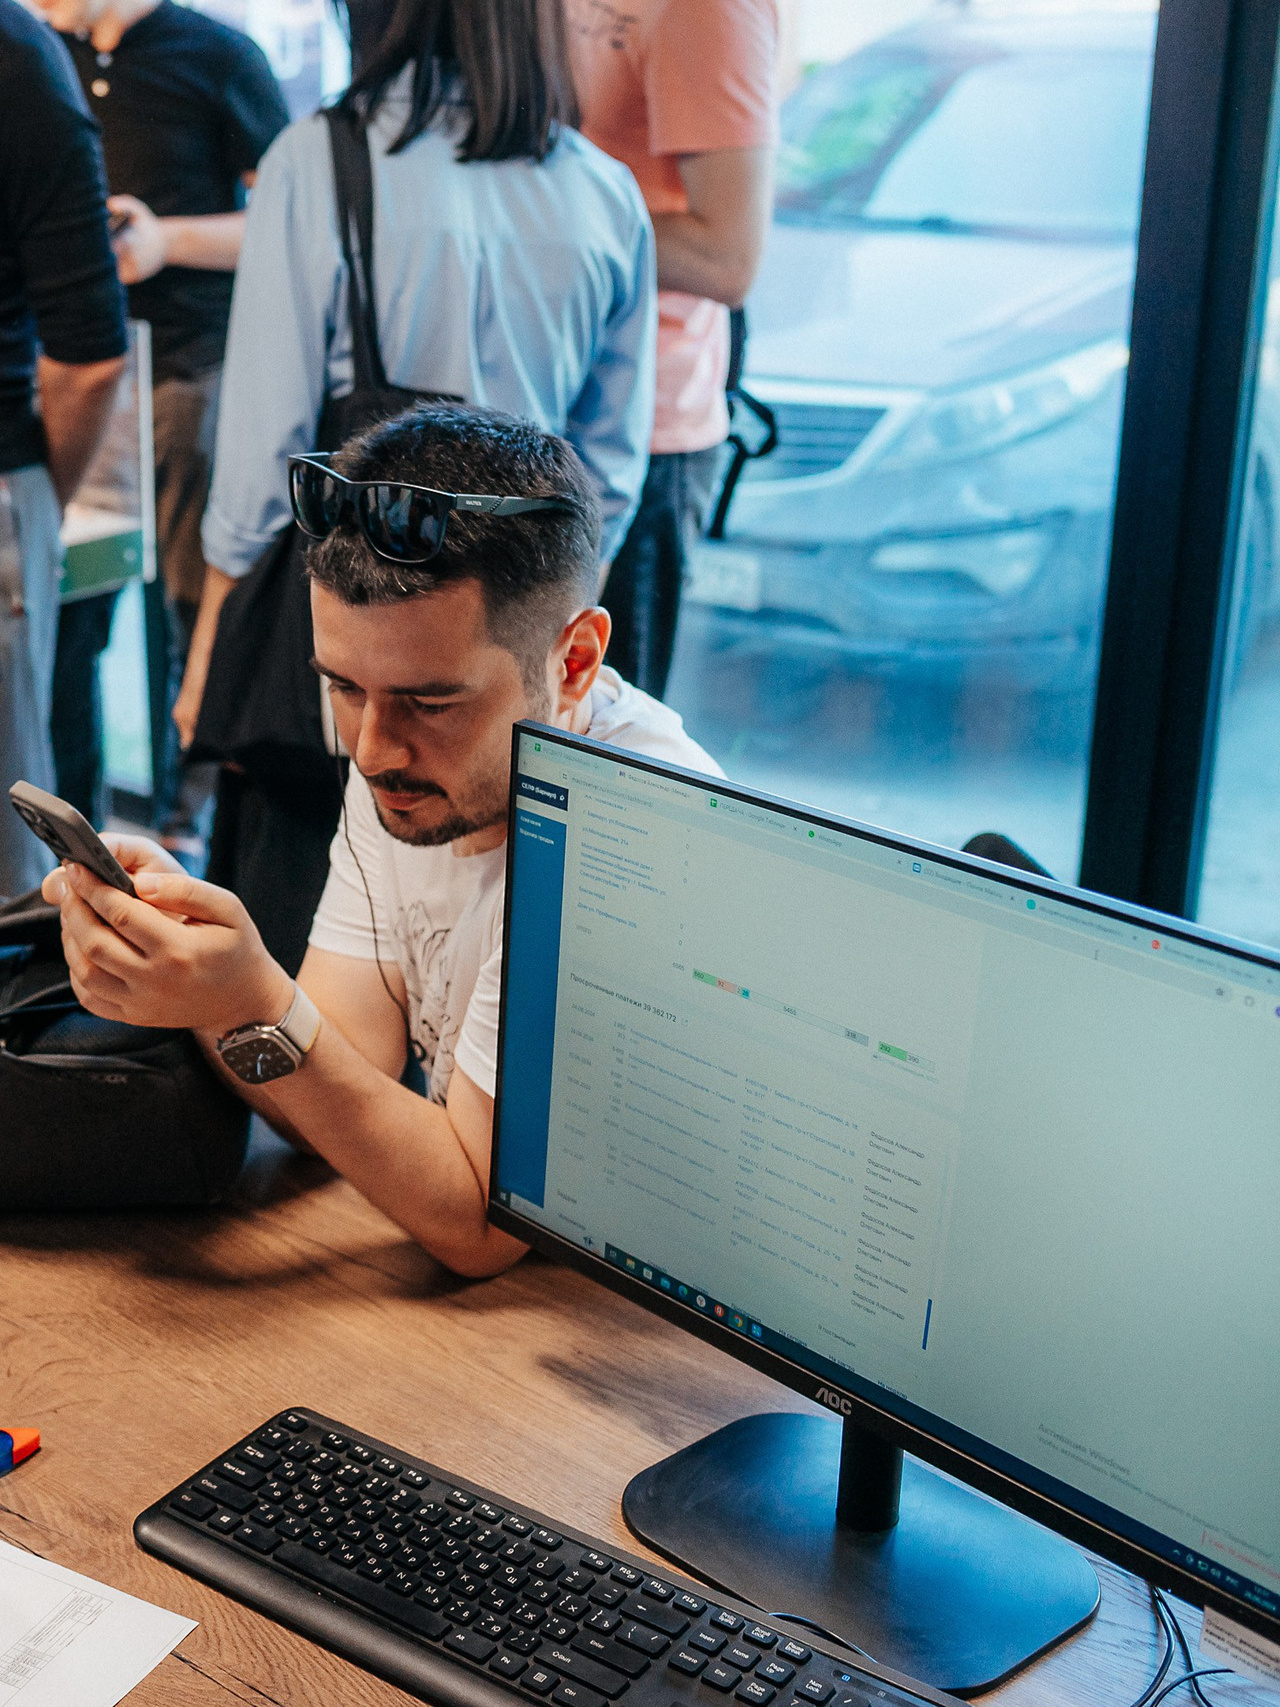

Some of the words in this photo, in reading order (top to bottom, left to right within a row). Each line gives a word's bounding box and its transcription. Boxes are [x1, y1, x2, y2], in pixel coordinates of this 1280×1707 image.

[818, 833, 842, 848] WhatsApp
[693, 969, 704, 980] 660
[717, 979, 724, 988] 92
[570, 972, 614, 998] Просроченные
[615, 991, 642, 1008] платежи
[642, 1002, 651, 1012] 39
[651, 1006, 664, 1017] 362
[665, 1012, 676, 1022] 172
[879, 1042, 891, 1053] 292
[868, 1139, 895, 1157] Олегович
[870, 1129, 894, 1146] Федосов
[894, 1140, 925, 1160] Александр
[865, 1166, 891, 1184] Олегович
[867, 1156, 891, 1174] Федосов
[891, 1167, 921, 1187] Александр
[862, 1193, 888, 1211] Олегович
[864, 1183, 888, 1201] Федосов
[888, 1194, 918, 1215] Александр
[859, 1220, 885, 1238] Олегович
[860, 1210, 885, 1228] Федосов
[885, 1221, 914, 1242] Александр
[857, 1237, 881, 1255] Федосов
[882, 1248, 911, 1269] Александр
[857, 1246, 882, 1264] Олегович
[853, 1272, 878, 1290] Олегович
[854, 1263, 878, 1281] Федосов
[878, 1274, 908, 1295] Александр
[850, 1298, 876, 1316] Олегович
[851, 1289, 875, 1307] Федосов
[875, 1301, 904, 1322] Александр
[816, 1388, 852, 1415] AOC
[1088, 1447, 1130, 1476] Windows
[619, 1566, 631, 1575] F10
[650, 1581, 662, 1589] F11
[682, 1595, 694, 1603] F12
[590, 1640, 605, 1649] Enter
[699, 1633, 716, 1643] Insert
[678, 1651, 698, 1664] Delete
[733, 1648, 749, 1659] Home
[714, 1668, 726, 1677] End
[770, 1662, 784, 1672] Page
[564, 1688, 577, 1697] Ctrl
